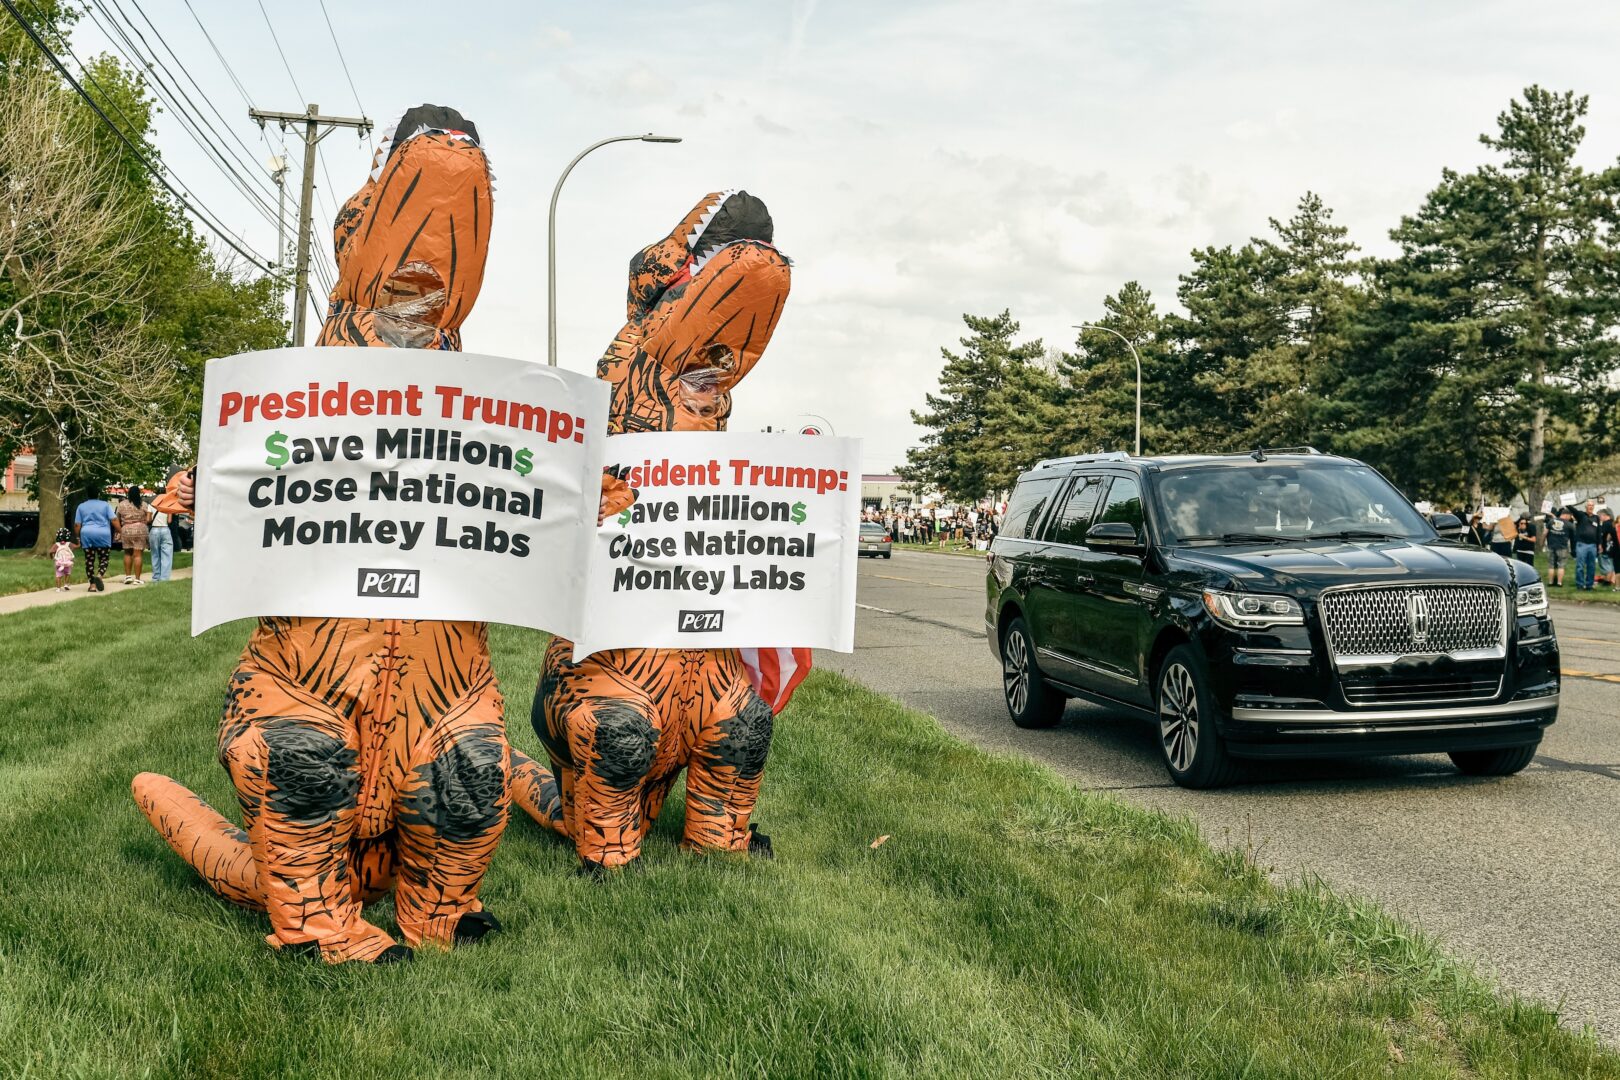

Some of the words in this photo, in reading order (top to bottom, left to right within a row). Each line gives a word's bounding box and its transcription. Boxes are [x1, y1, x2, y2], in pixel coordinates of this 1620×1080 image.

[218, 382, 423, 427] President
[434, 385, 585, 444] Trump:
[264, 430, 364, 471] $ave
[375, 428, 534, 477] Million$
[248, 475, 358, 509] Close
[369, 471, 544, 520] National
[603, 458, 721, 489] sident
[729, 459, 849, 495] Trump:
[687, 494, 808, 526] Million$
[262, 513, 425, 551] Monkey
[435, 517, 531, 558] Labs
[609, 533, 677, 559] Close
[684, 530, 816, 558] National
[613, 565, 726, 596] Monkey
[733, 565, 806, 591] Labs
